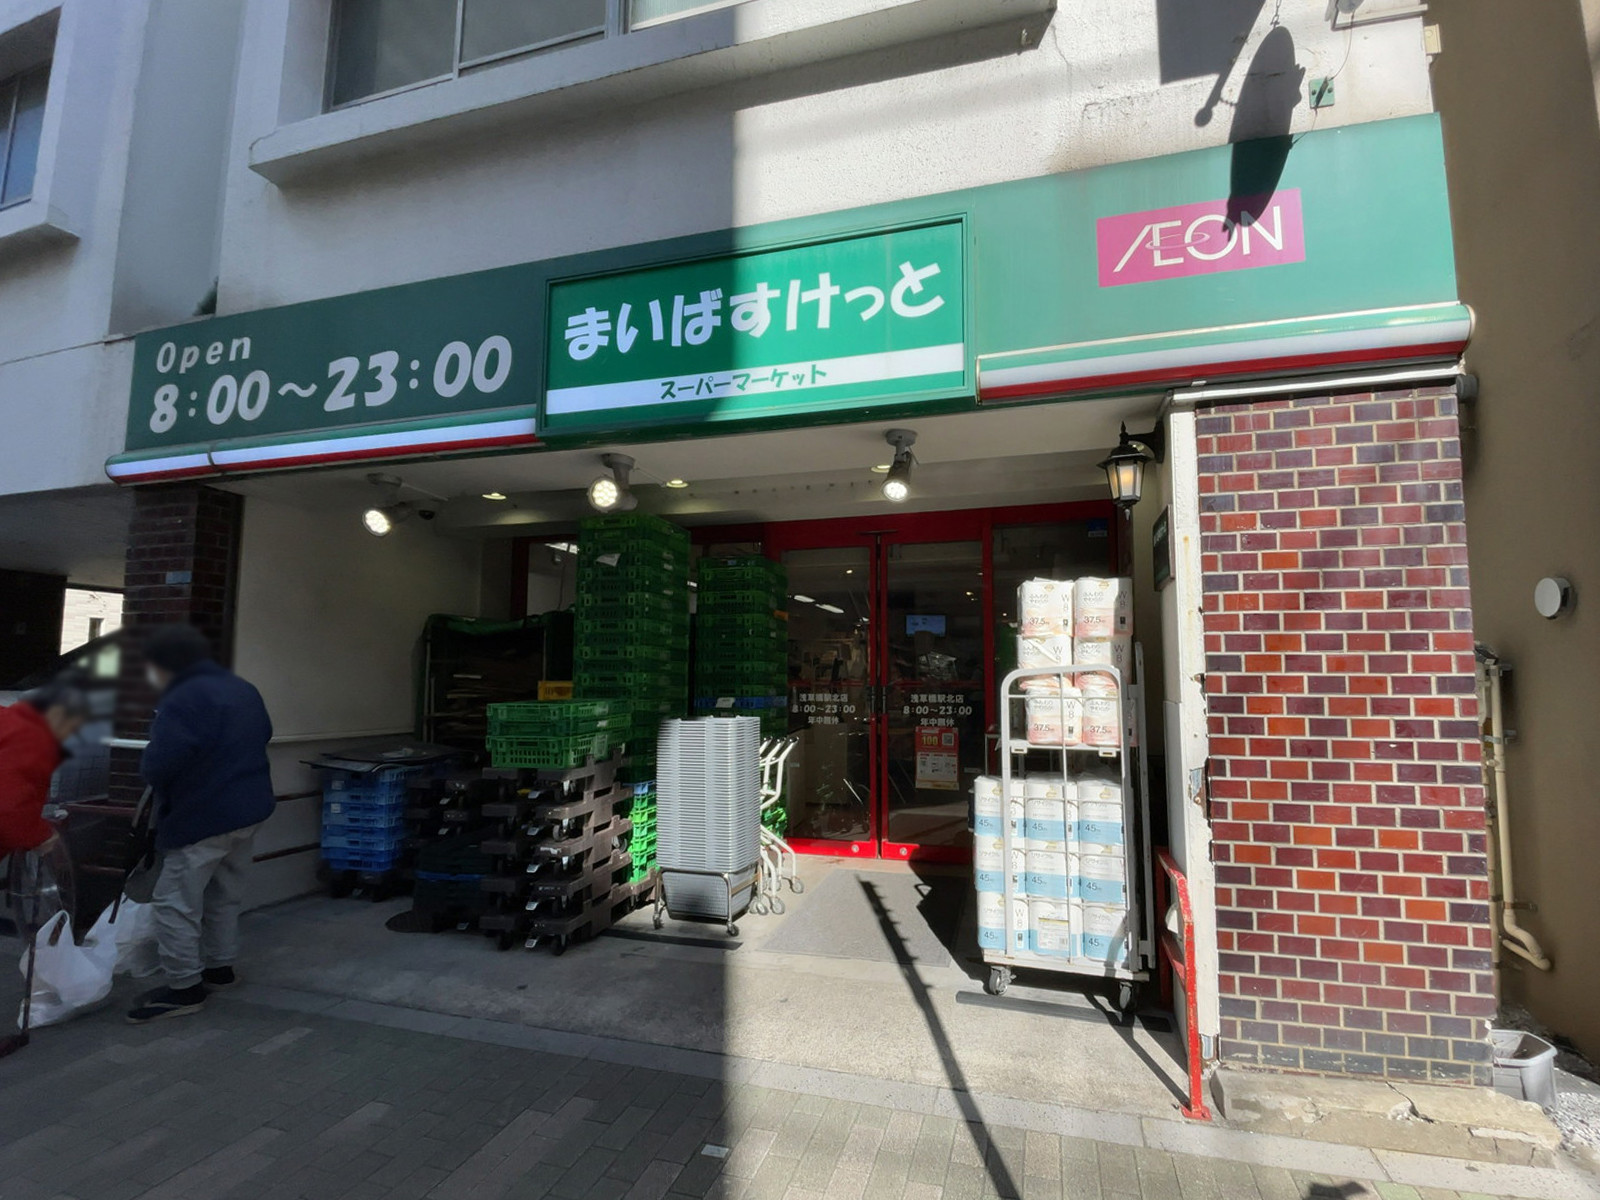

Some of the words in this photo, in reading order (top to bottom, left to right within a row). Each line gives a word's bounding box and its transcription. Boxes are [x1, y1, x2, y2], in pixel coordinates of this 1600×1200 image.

[564, 260, 945, 361] まいばすけっと
[156, 336, 251, 374] Open
[660, 364, 827, 400] スーパーマーケット
